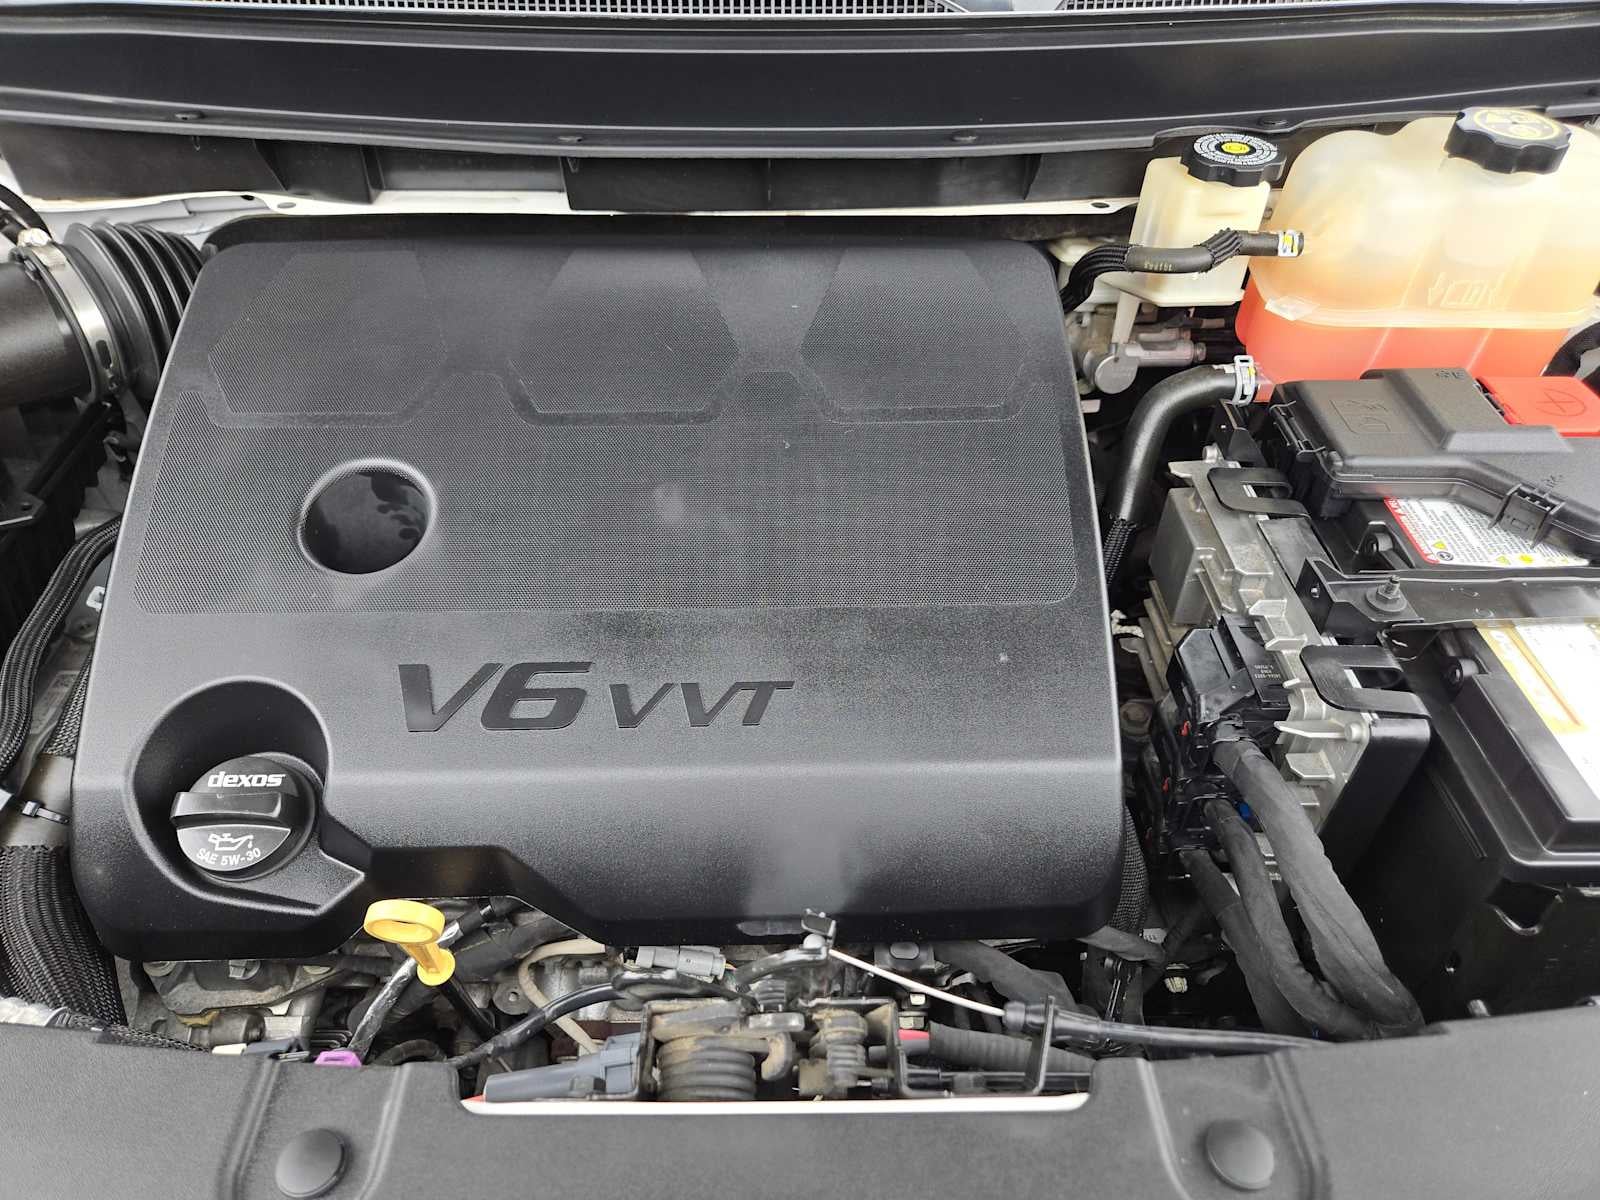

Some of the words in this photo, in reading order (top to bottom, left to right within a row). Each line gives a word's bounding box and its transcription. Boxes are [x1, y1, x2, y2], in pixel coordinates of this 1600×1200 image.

[398, 661, 593, 733] V6
[609, 680, 795, 729] VVT
[207, 771, 286, 788] dexos
[196, 847, 219, 865] SAE
[220, 847, 261, 866] 5W-30
